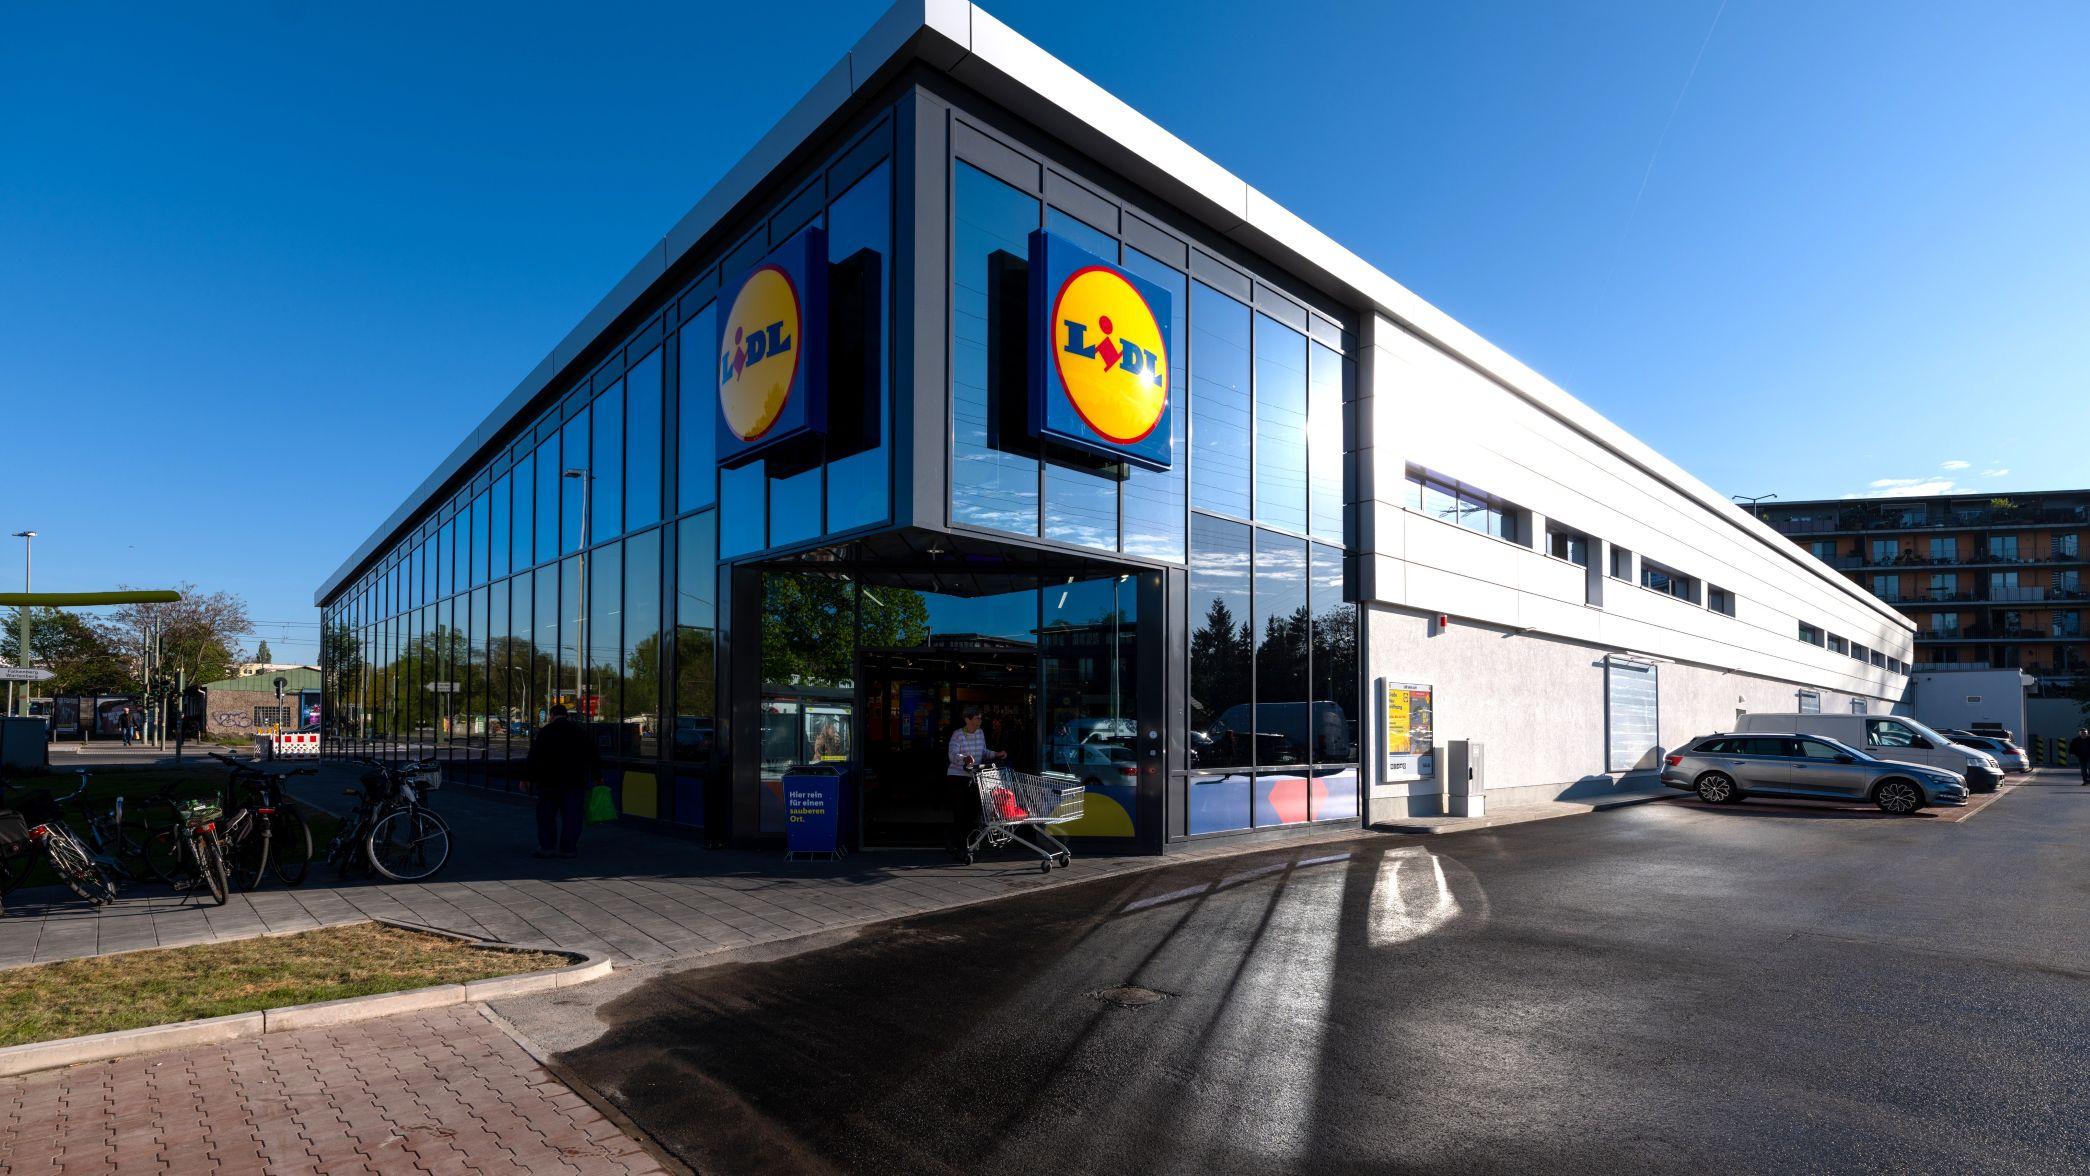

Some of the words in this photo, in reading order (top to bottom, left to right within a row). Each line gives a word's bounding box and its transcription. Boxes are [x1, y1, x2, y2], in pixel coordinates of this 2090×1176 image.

[789, 790, 806, 798] Hier
[807, 790, 823, 798] rein
[790, 815, 805, 823] Ort.
